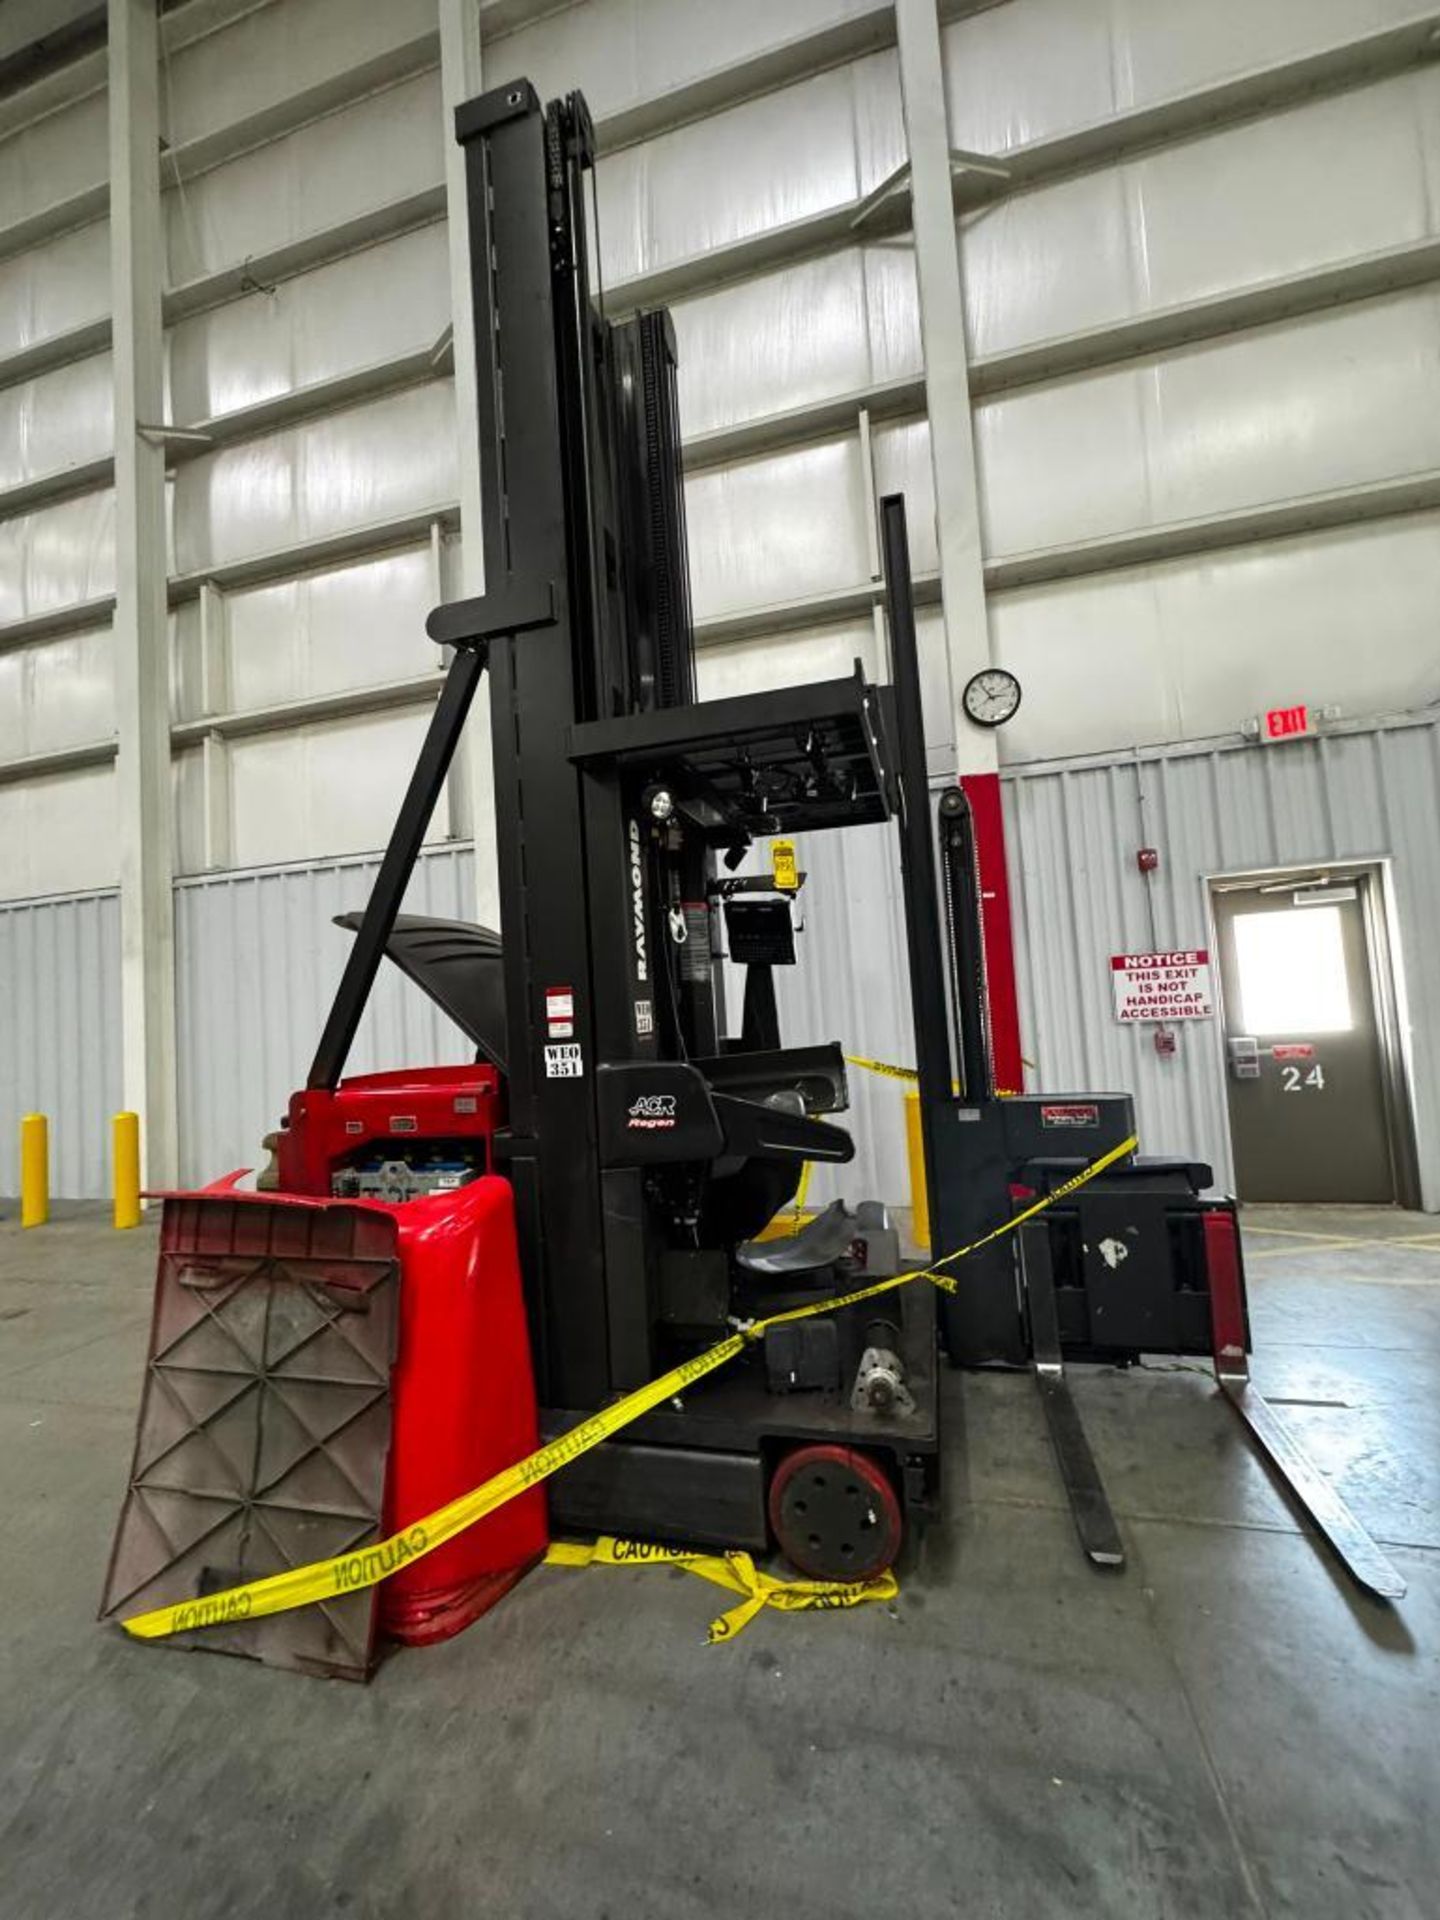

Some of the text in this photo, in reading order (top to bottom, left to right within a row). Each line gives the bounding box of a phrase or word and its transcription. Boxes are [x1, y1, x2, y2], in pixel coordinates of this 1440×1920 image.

[1267, 706, 1306, 737] EXIT
[629, 819, 647, 980] RAYMOND
[1124, 952, 1198, 968] NOTICE
[1126, 968, 1198, 981] THIS EXIT
[1139, 981, 1187, 993] IS NOT
[1126, 993, 1203, 1006] HANDICAP
[1120, 1005, 1212, 1018] ACCESSIBLE
[550, 1062, 578, 1076] 351
[1281, 1064, 1325, 1091] 24
[629, 1095, 676, 1116] ACR
